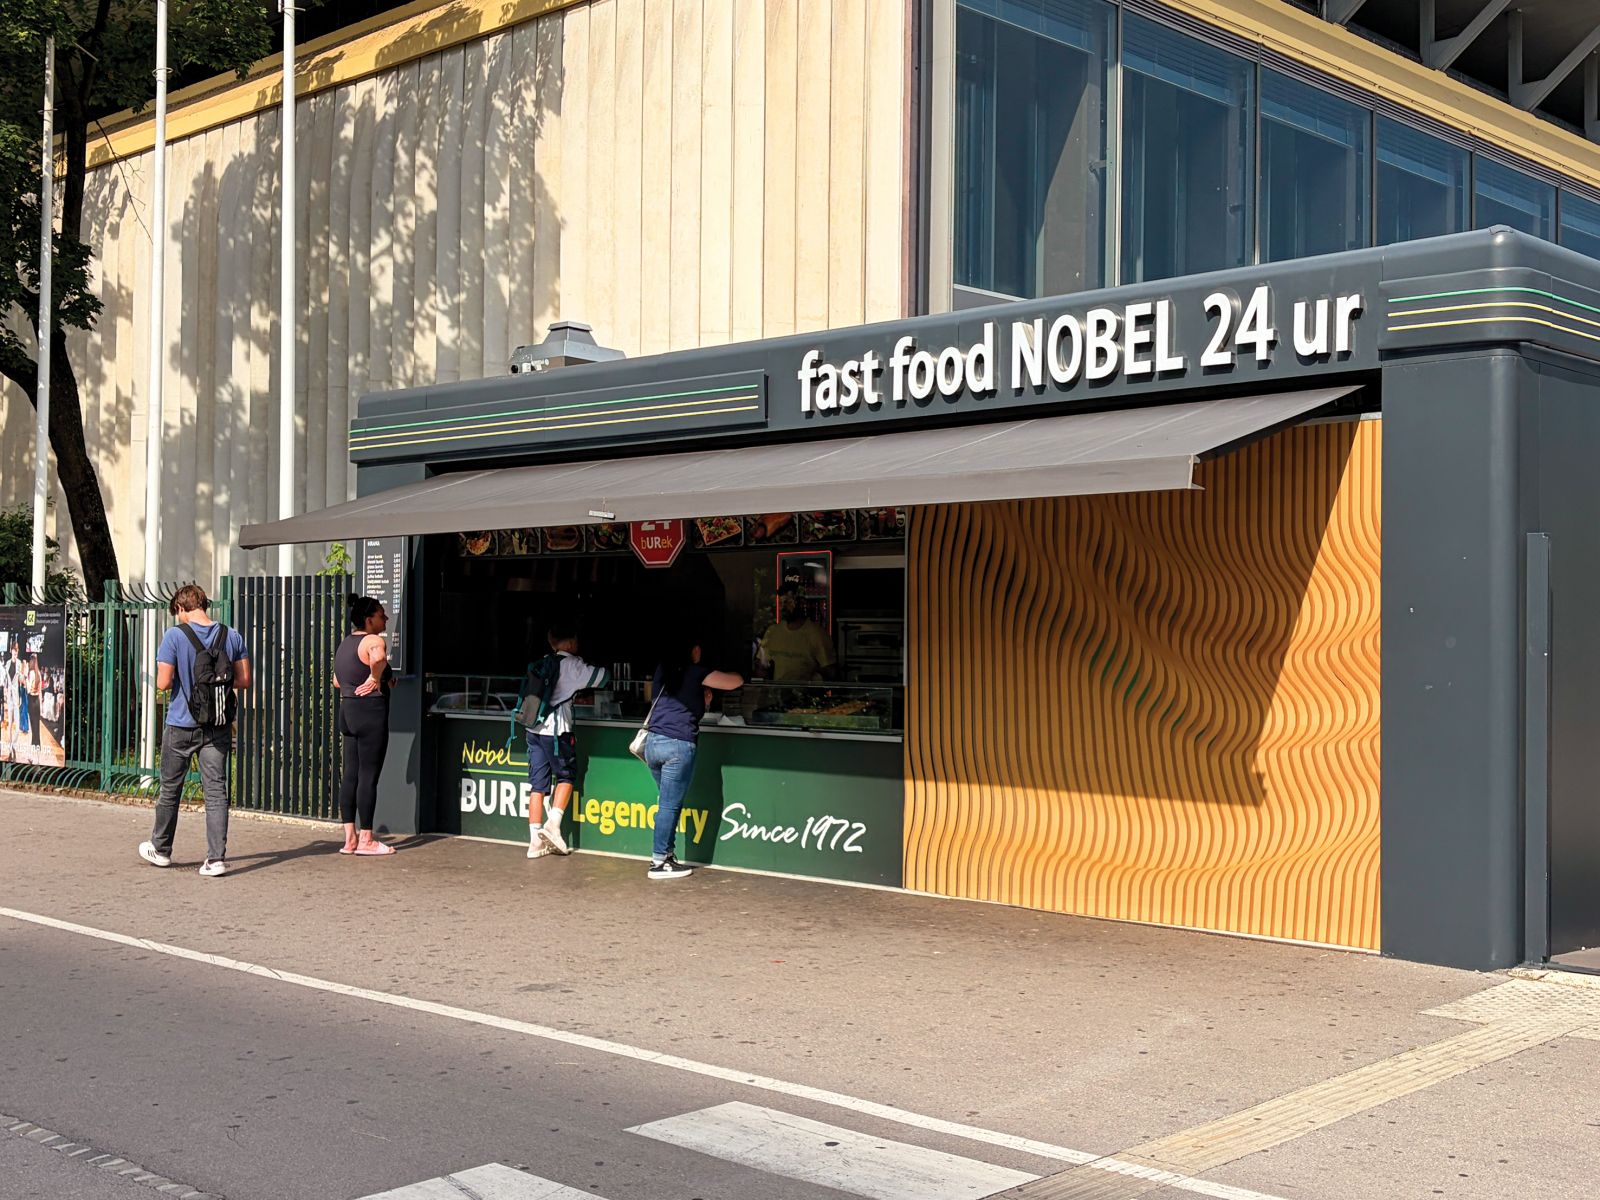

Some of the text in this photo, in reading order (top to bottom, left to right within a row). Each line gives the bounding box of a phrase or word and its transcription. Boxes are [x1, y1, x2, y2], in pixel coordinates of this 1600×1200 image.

[797, 286, 1361, 412] fast food NOBEL 24 ur
[461, 740, 528, 767] Nobel
[720, 802, 799, 843] Since
[800, 815, 867, 853] 1972
